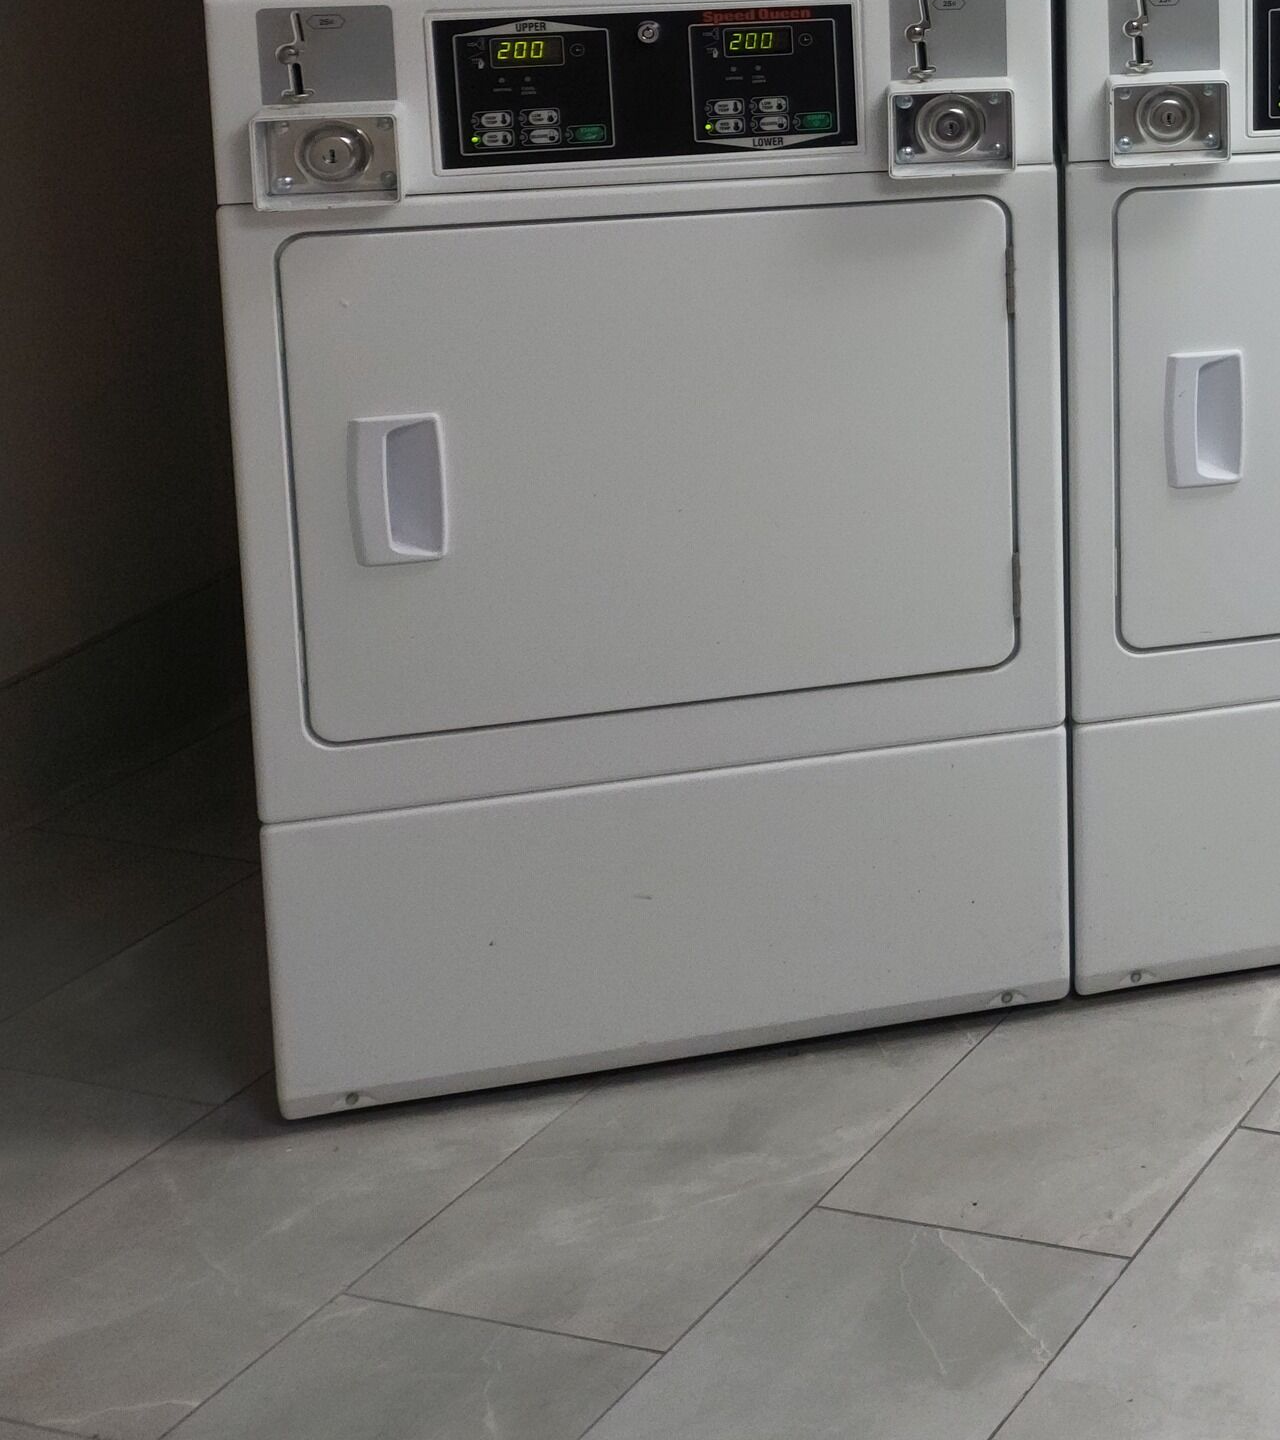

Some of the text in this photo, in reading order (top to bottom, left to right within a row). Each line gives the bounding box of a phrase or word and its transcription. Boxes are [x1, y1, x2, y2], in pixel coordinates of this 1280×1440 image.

[703, 8, 811, 24] Speed Queen
[515, 22, 547, 32] UPPER
[752, 137, 784, 147] LOWER
